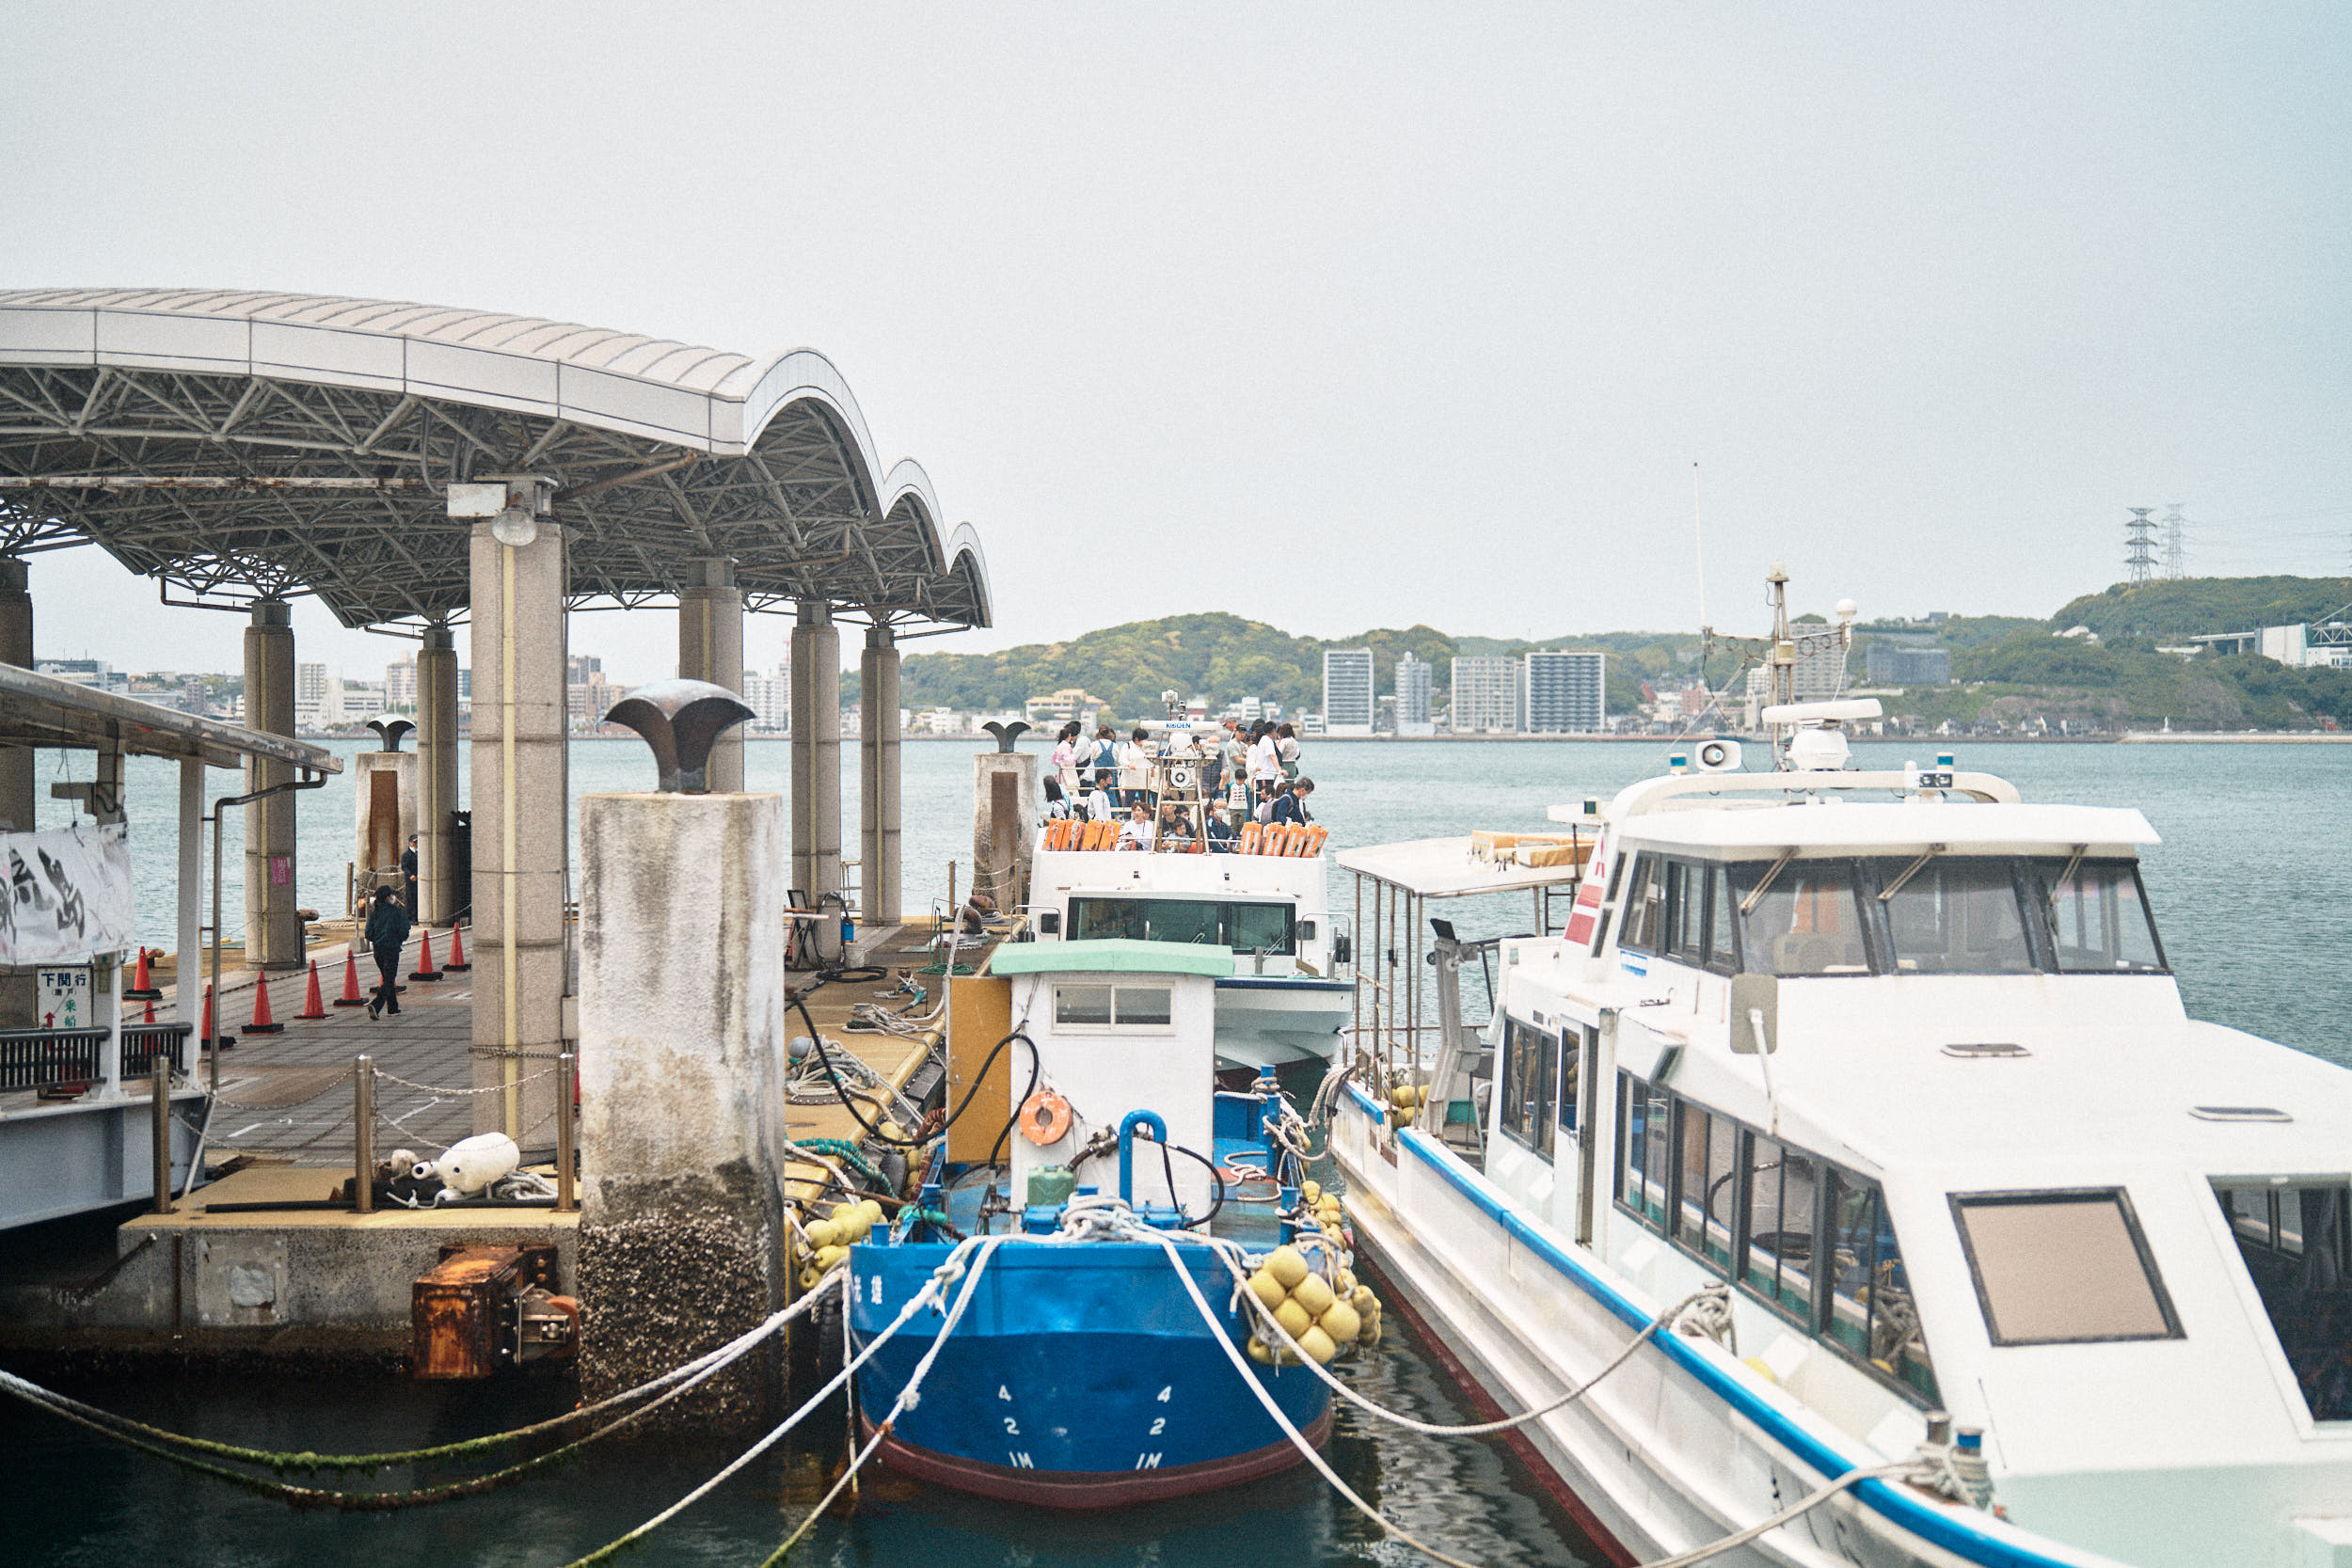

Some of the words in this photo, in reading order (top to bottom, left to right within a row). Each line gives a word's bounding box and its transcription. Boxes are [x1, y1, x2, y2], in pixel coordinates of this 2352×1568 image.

[40, 973, 87, 987] 下関行
[998, 1385, 1012, 1402] 4
[1157, 1386, 1172, 1402] 4
[1004, 1417, 1020, 1435] 2
[1150, 1418, 1166, 1435] 2
